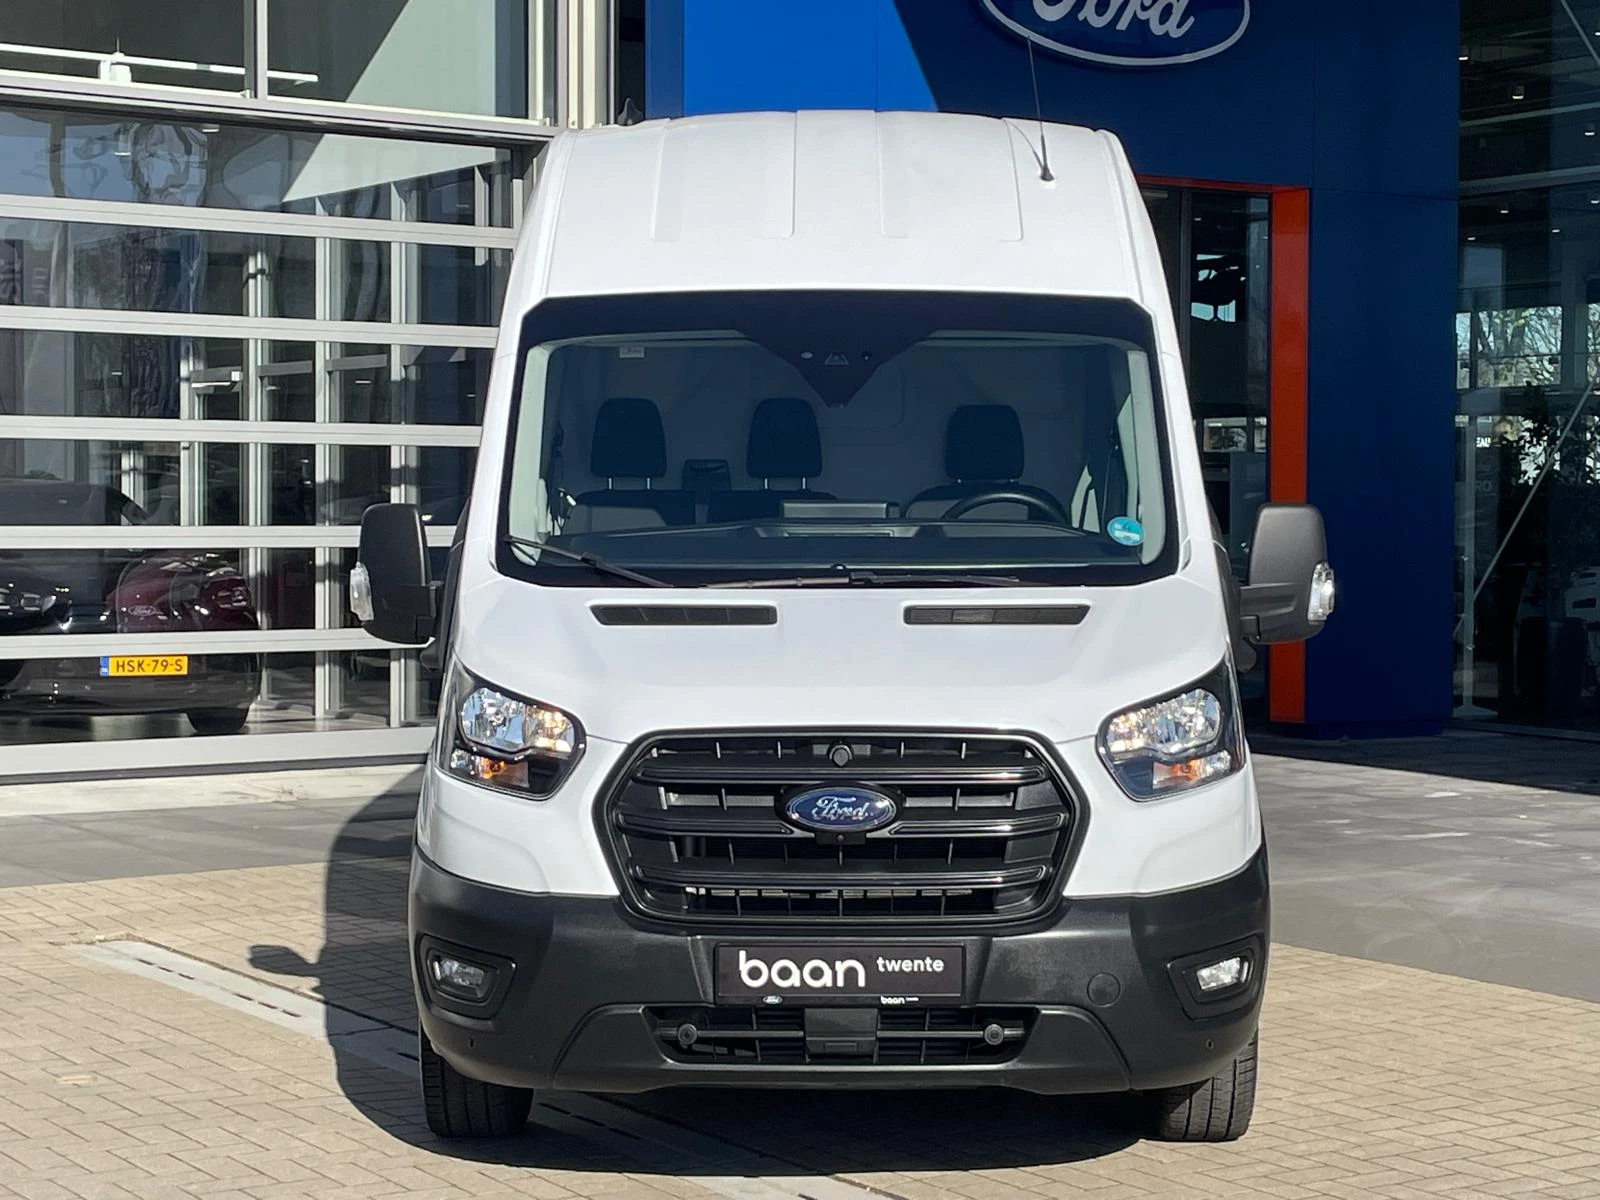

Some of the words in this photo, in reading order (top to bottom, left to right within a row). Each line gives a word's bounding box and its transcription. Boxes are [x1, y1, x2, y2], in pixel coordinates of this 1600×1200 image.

[116, 659, 183, 673] HSK-79-S
[811, 796, 870, 820] Ford
[738, 950, 866, 988] baan
[876, 956, 945, 973] twente
[880, 995, 906, 1005] baan
